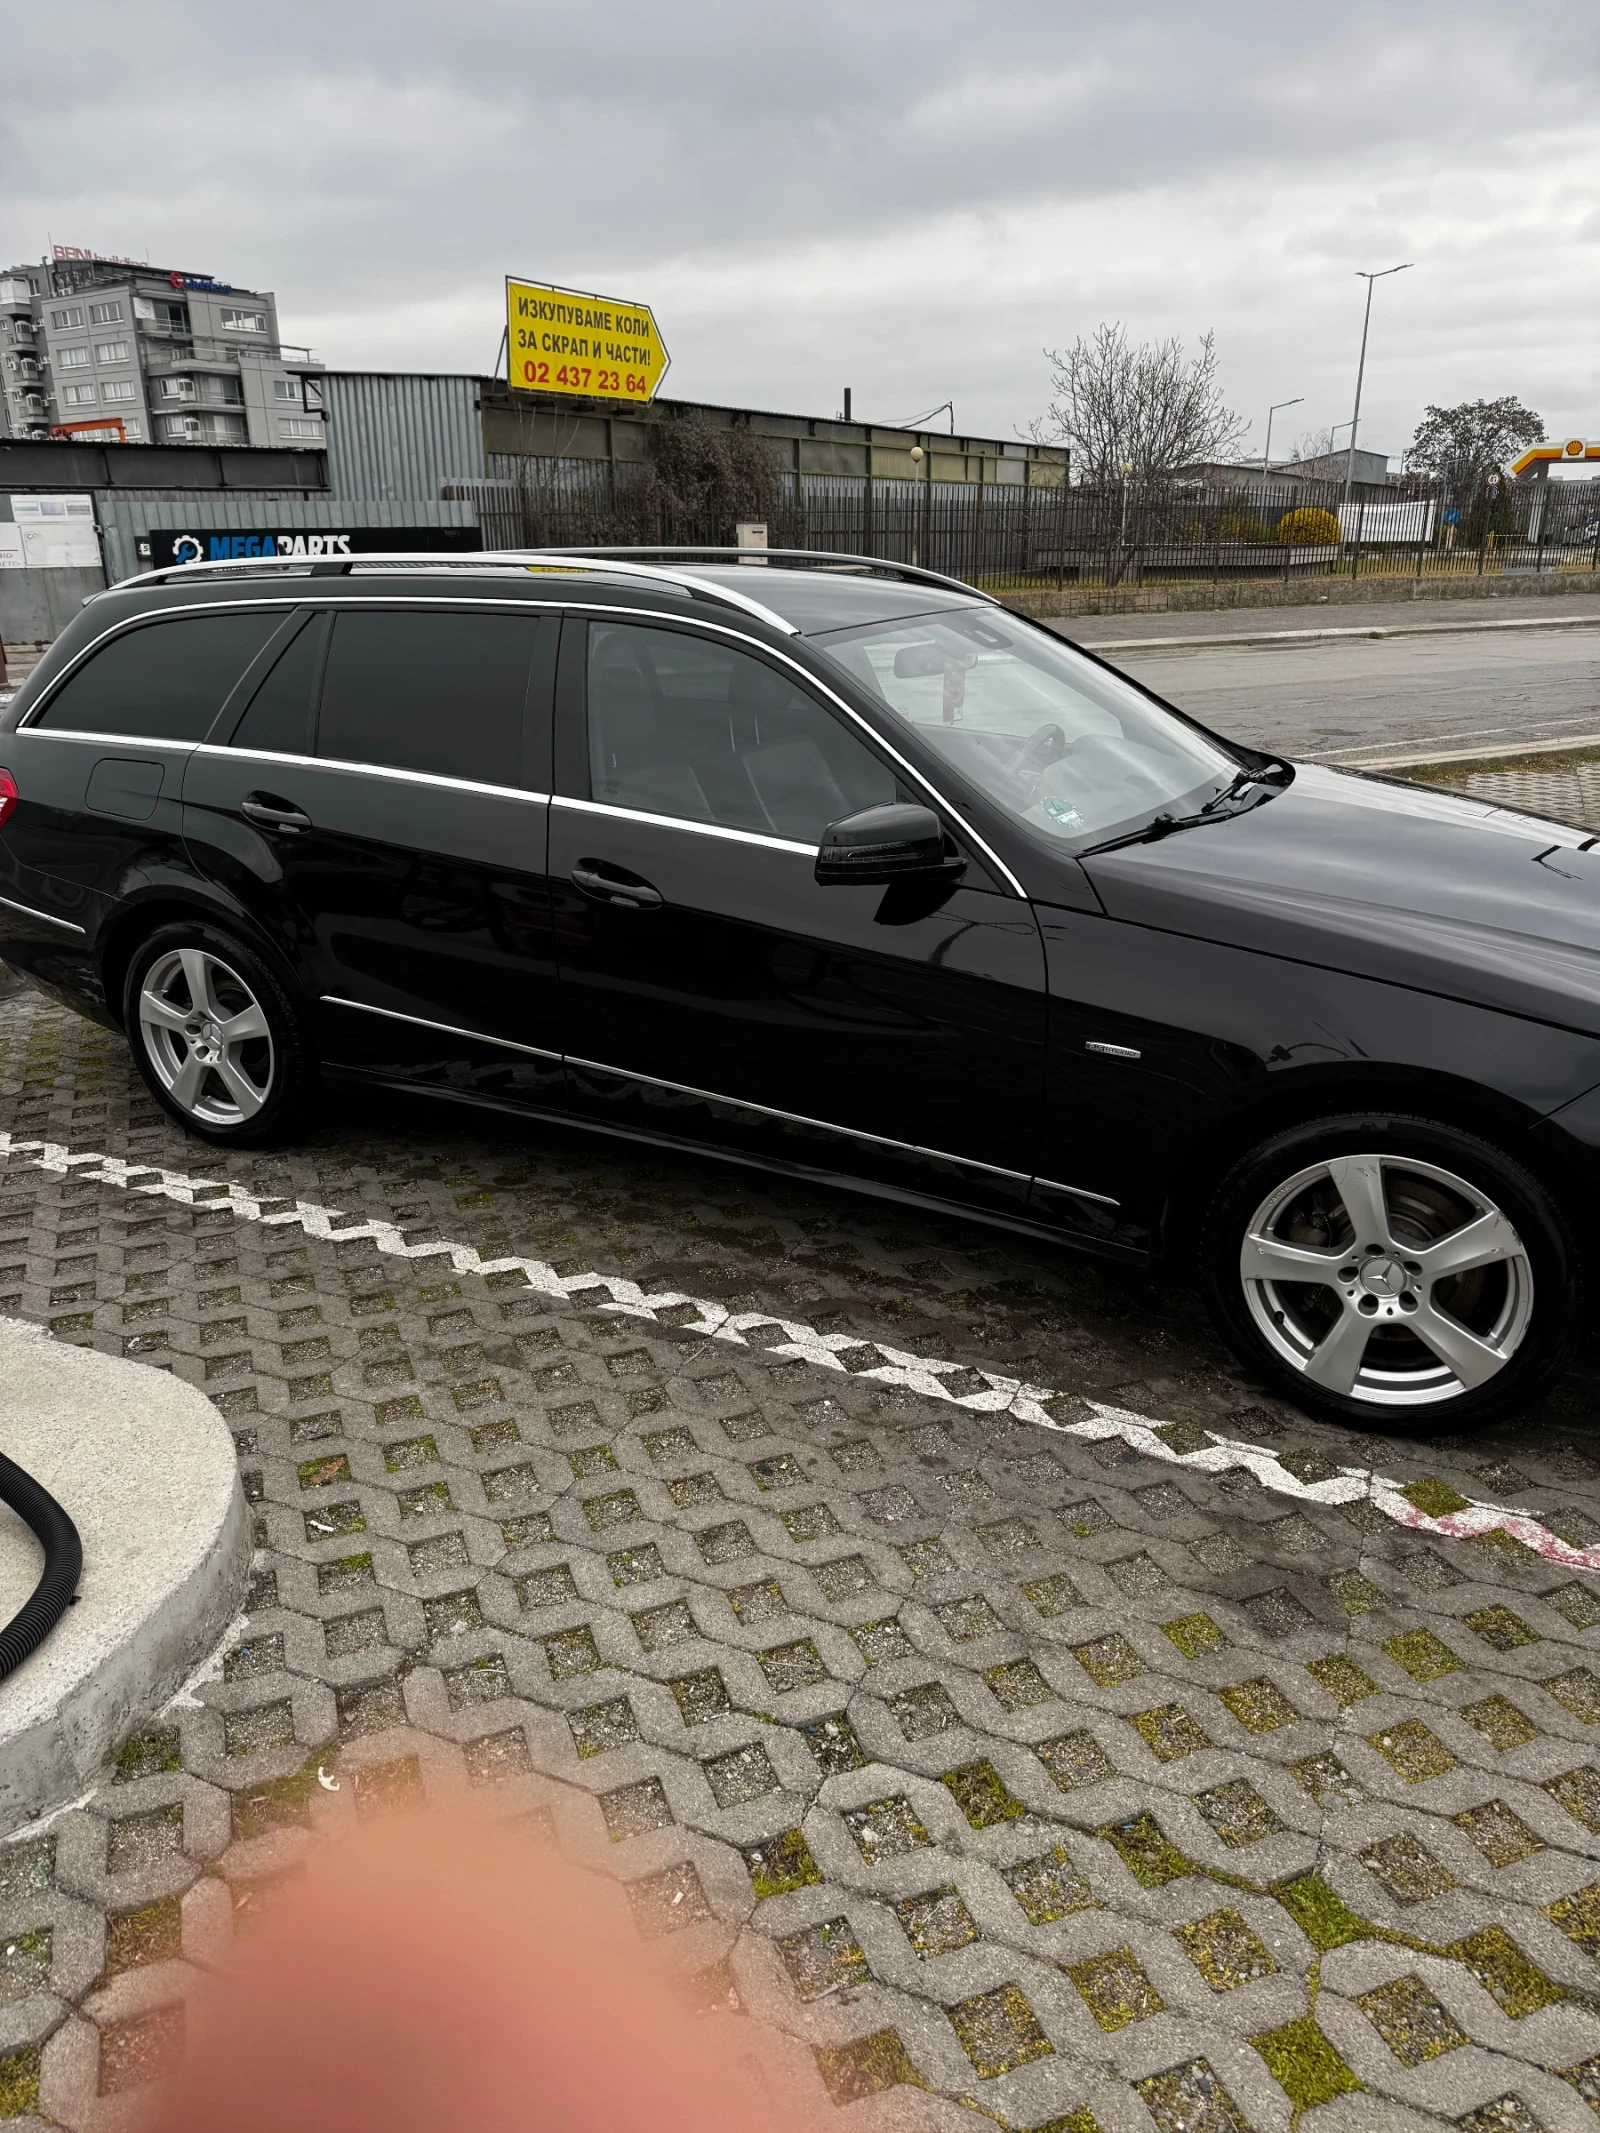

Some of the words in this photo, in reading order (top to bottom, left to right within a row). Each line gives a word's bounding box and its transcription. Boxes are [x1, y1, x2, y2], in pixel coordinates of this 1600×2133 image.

[518, 297, 612, 331] ИЗКУПУВАМЕ
[616, 312, 650, 338] КОЛИ
[518, 329, 538, 350] ЗА
[542, 333, 588, 357] СКРАП
[593, 340, 602, 359] И
[606, 342, 651, 366] ЧАСТИ!
[524, 360, 550, 384] 02
[557, 365, 592, 388] 437
[598, 370, 620, 391] 23
[626, 374, 647, 394] 64
[210, 535, 351, 560] MEGAPARTS
